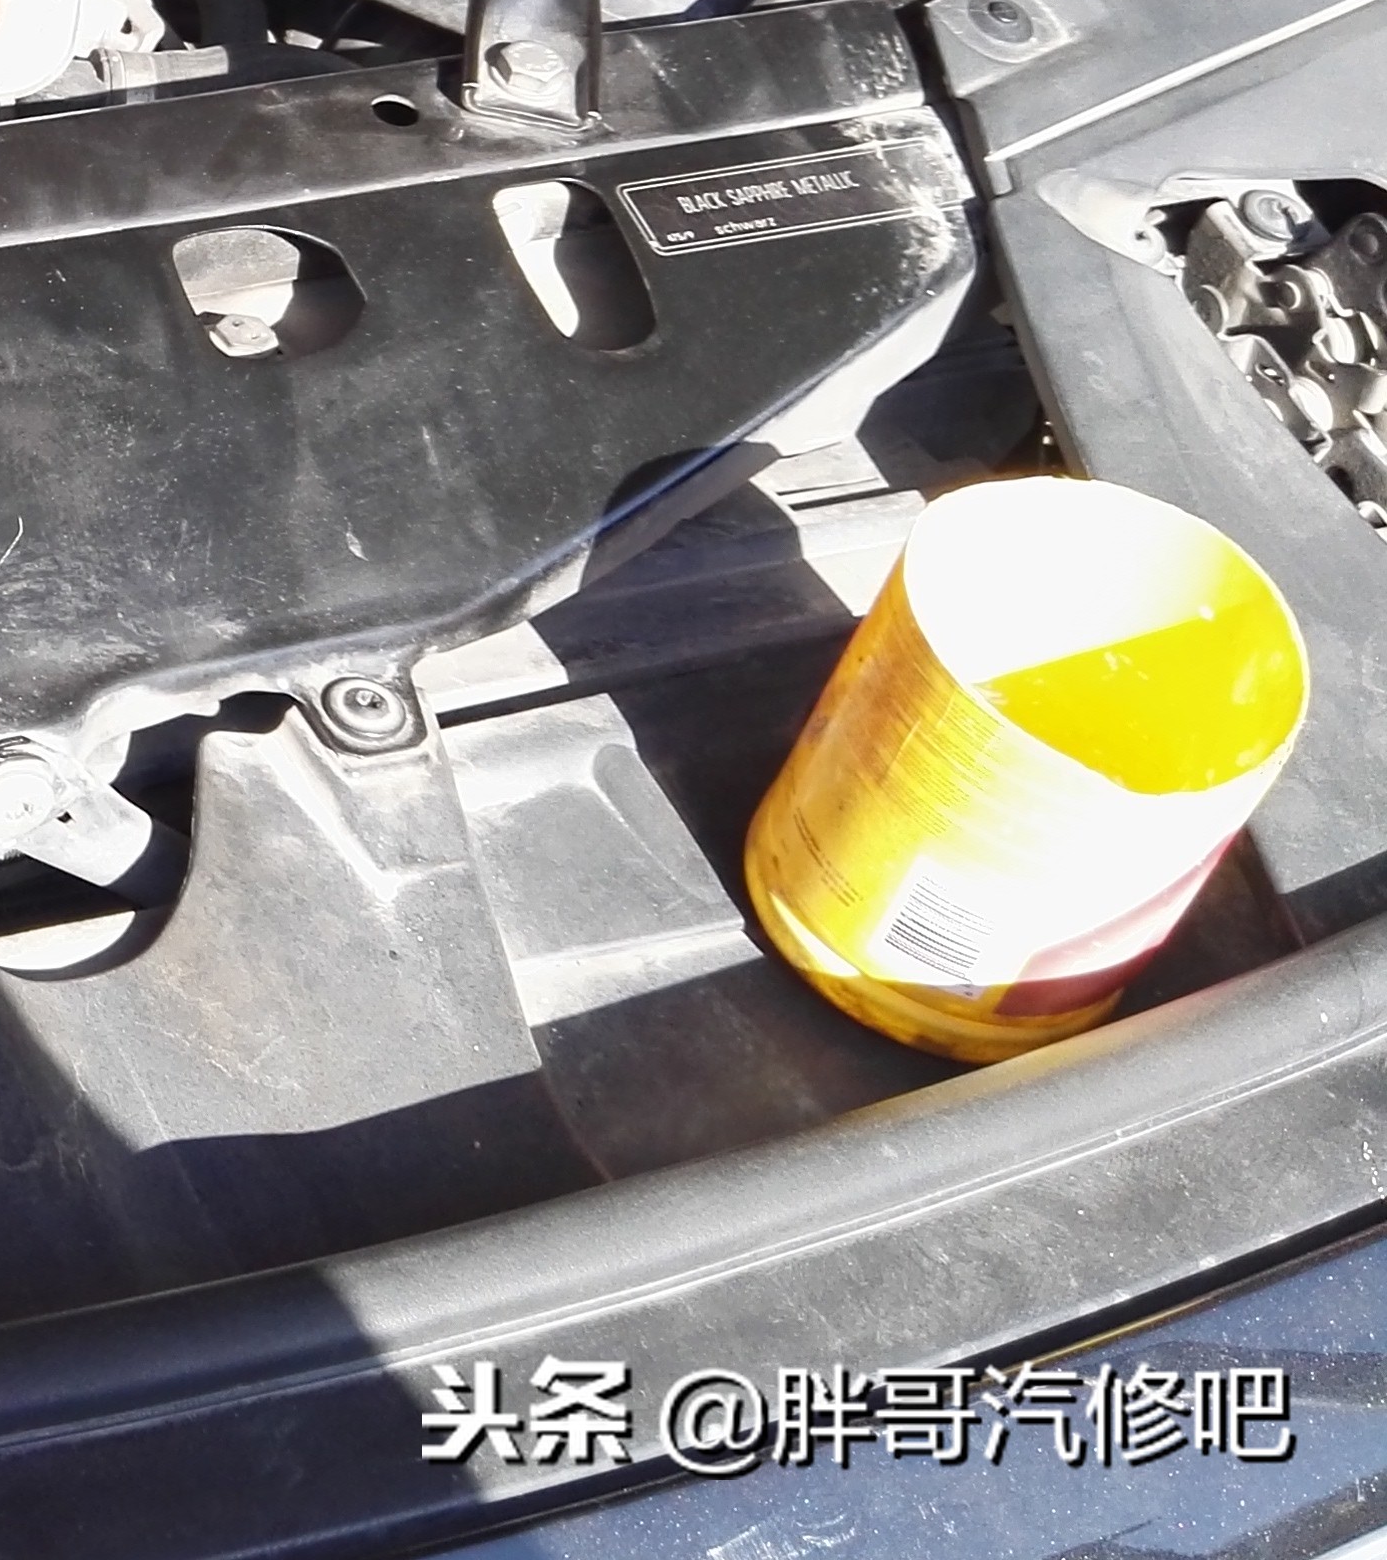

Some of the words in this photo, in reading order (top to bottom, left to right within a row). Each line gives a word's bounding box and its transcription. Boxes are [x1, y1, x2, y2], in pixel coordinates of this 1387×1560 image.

[677, 191, 728, 214] BLACK
[726, 180, 793, 206] SAPPHIRE
[790, 170, 861, 195] METALLIC
[714, 216, 778, 236] schwarz
